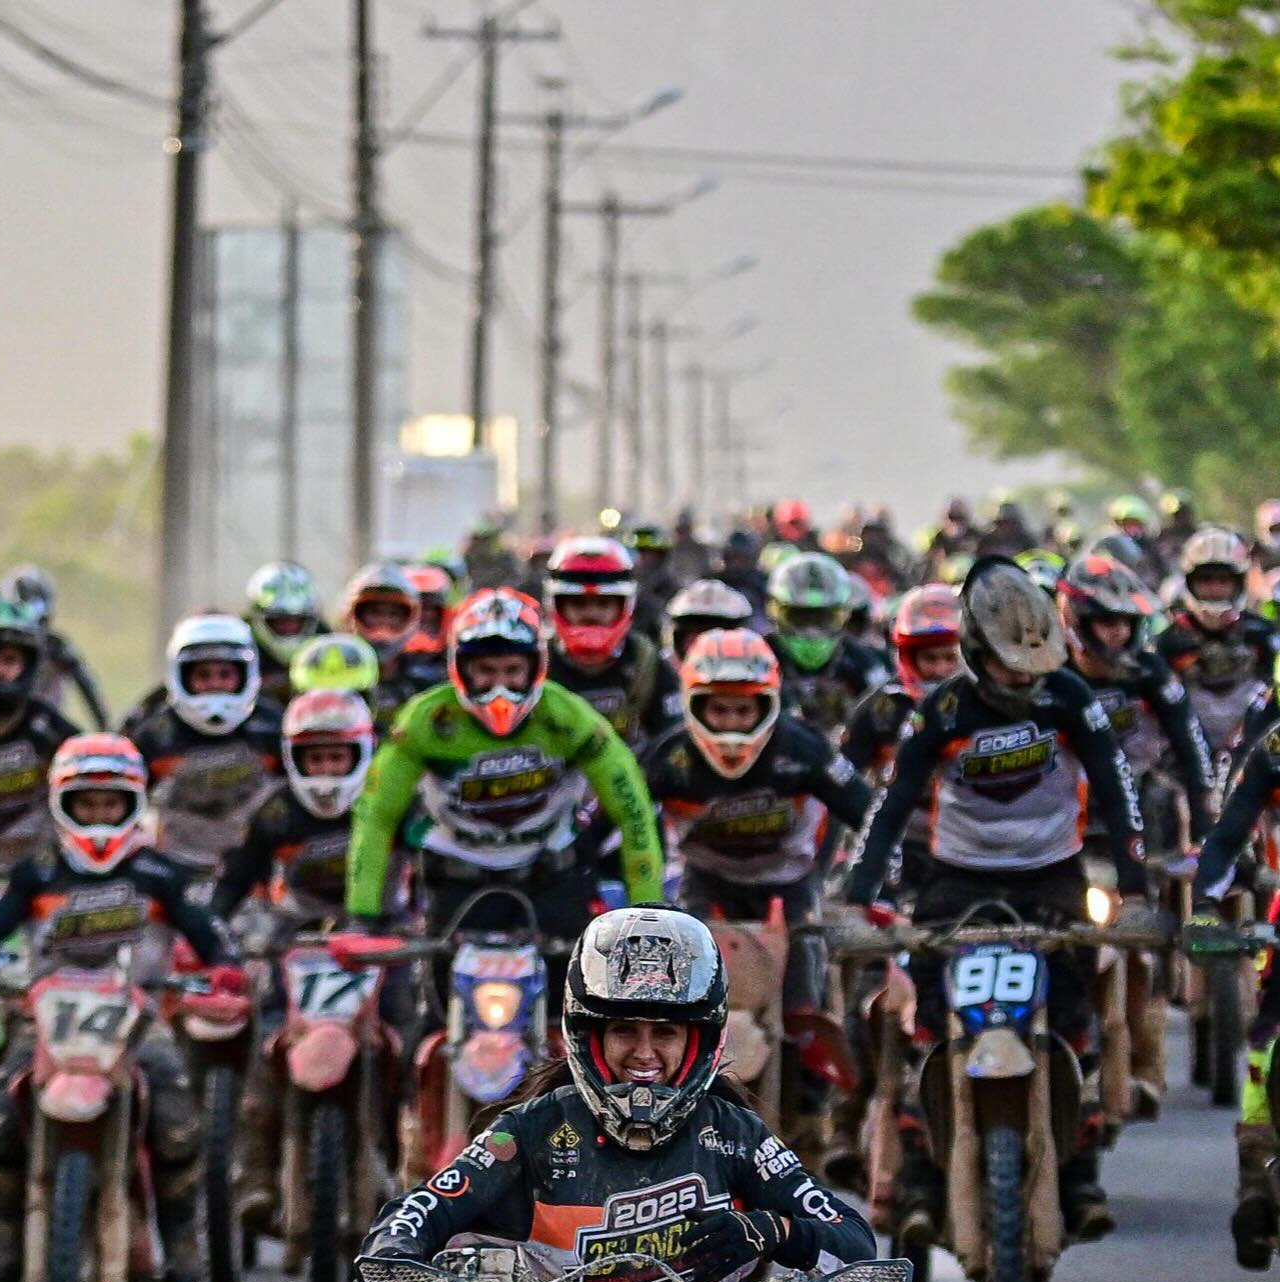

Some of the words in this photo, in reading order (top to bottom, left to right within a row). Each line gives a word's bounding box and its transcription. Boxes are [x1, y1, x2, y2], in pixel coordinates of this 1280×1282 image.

[978, 730, 1033, 753] 2025
[299, 969, 371, 1010] 17
[953, 952, 1038, 1008] 98
[48, 1000, 128, 1044] 14
[615, 1186, 697, 1228] 2025
